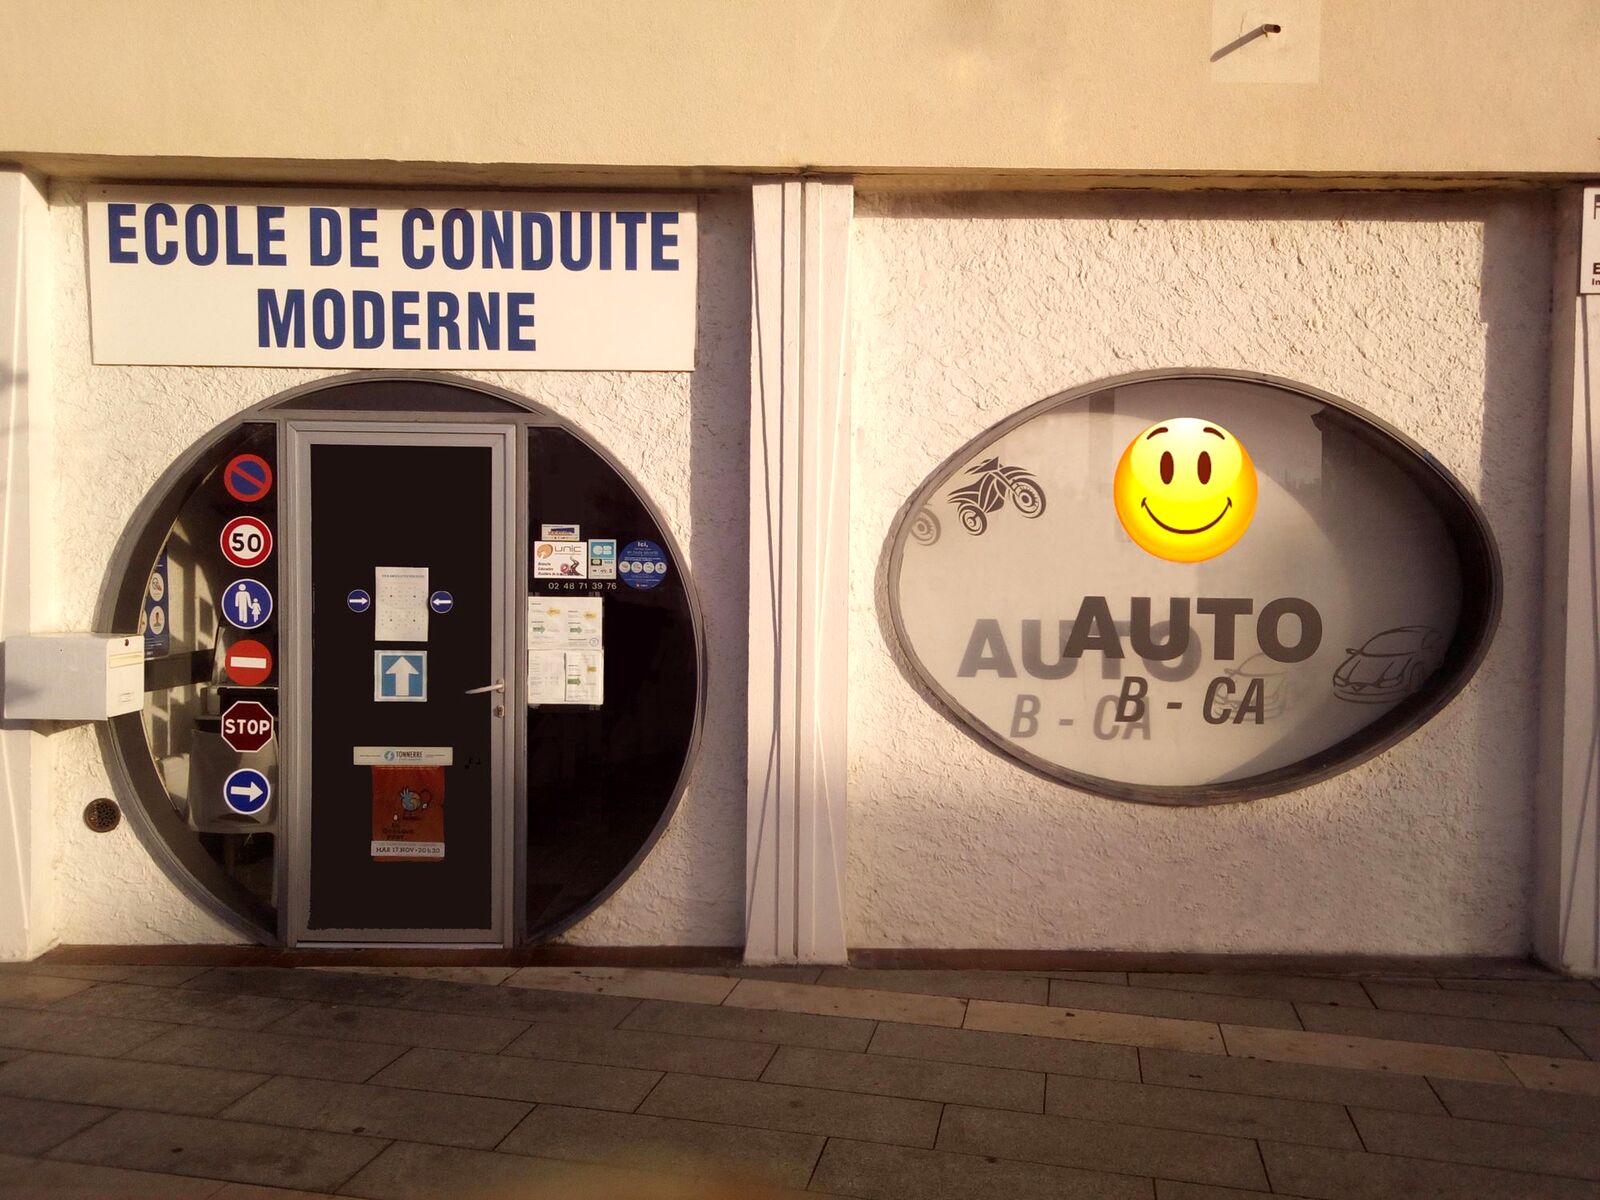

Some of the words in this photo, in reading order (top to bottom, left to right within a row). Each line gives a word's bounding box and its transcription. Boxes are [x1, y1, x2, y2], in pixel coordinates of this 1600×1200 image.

[107, 202, 287, 267] ECOLE
[308, 206, 380, 269] DE
[401, 208, 680, 272] CONDUITE
[257, 287, 537, 353] MODERNE
[231, 532, 262, 553] 50
[548, 582, 559, 590] 02
[563, 582, 575, 590] 48
[579, 582, 588, 590] 71
[592, 582, 603, 590] 39
[606, 582, 617, 590] 76
[1061, 595, 1323, 664] AUTO
[1114, 676, 1149, 723] B
[1202, 676, 1265, 725] CA
[224, 718, 271, 736] STOP
